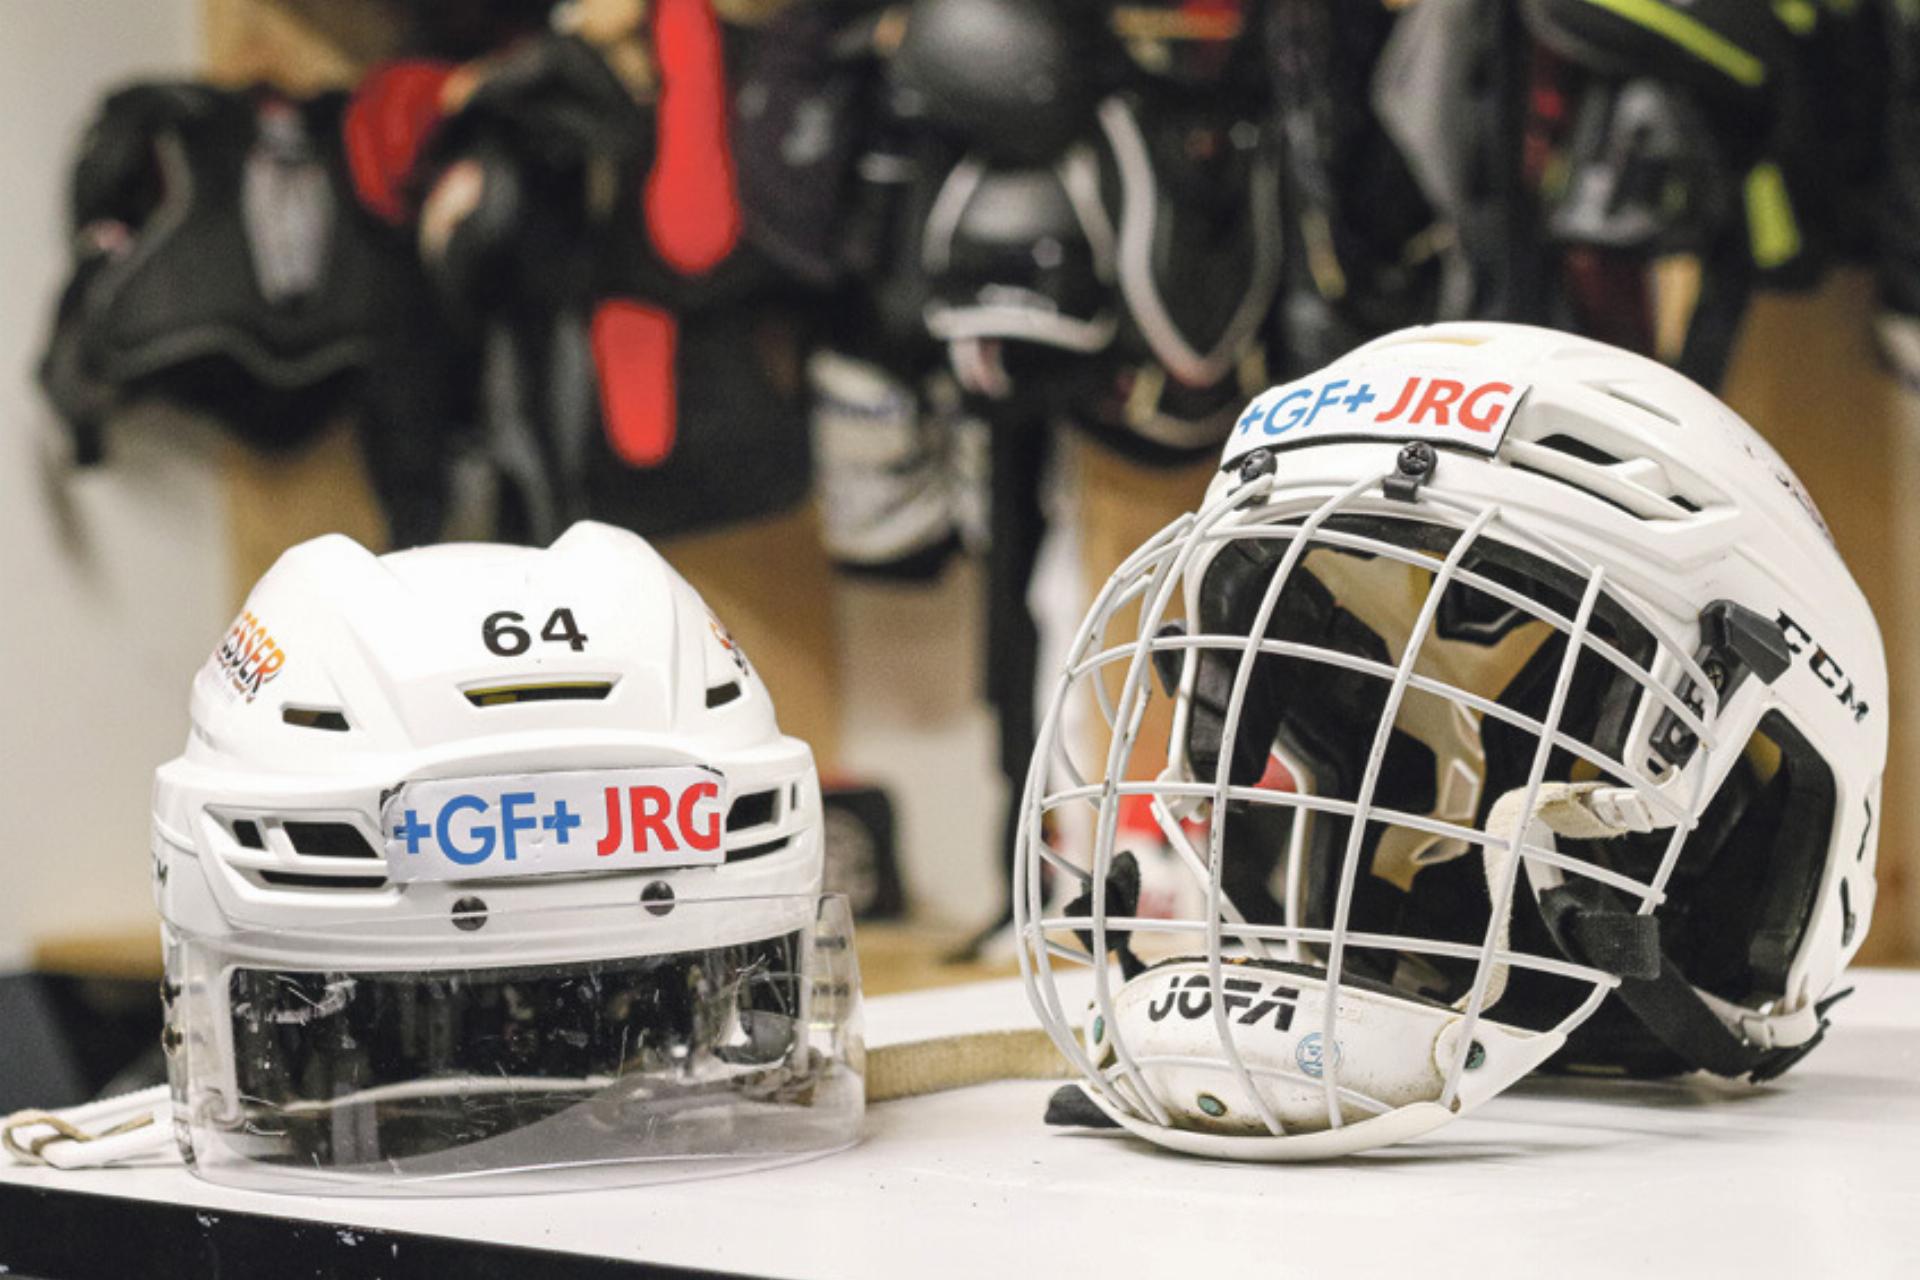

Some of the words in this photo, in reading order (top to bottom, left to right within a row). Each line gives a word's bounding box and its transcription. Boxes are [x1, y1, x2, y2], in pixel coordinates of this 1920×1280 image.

[1374, 376, 1514, 433] JRG
[481, 607, 589, 657] 64
[1774, 608, 1870, 724] CCM
[597, 781, 721, 857] JRG
[1148, 974, 1300, 1033] JOFA
